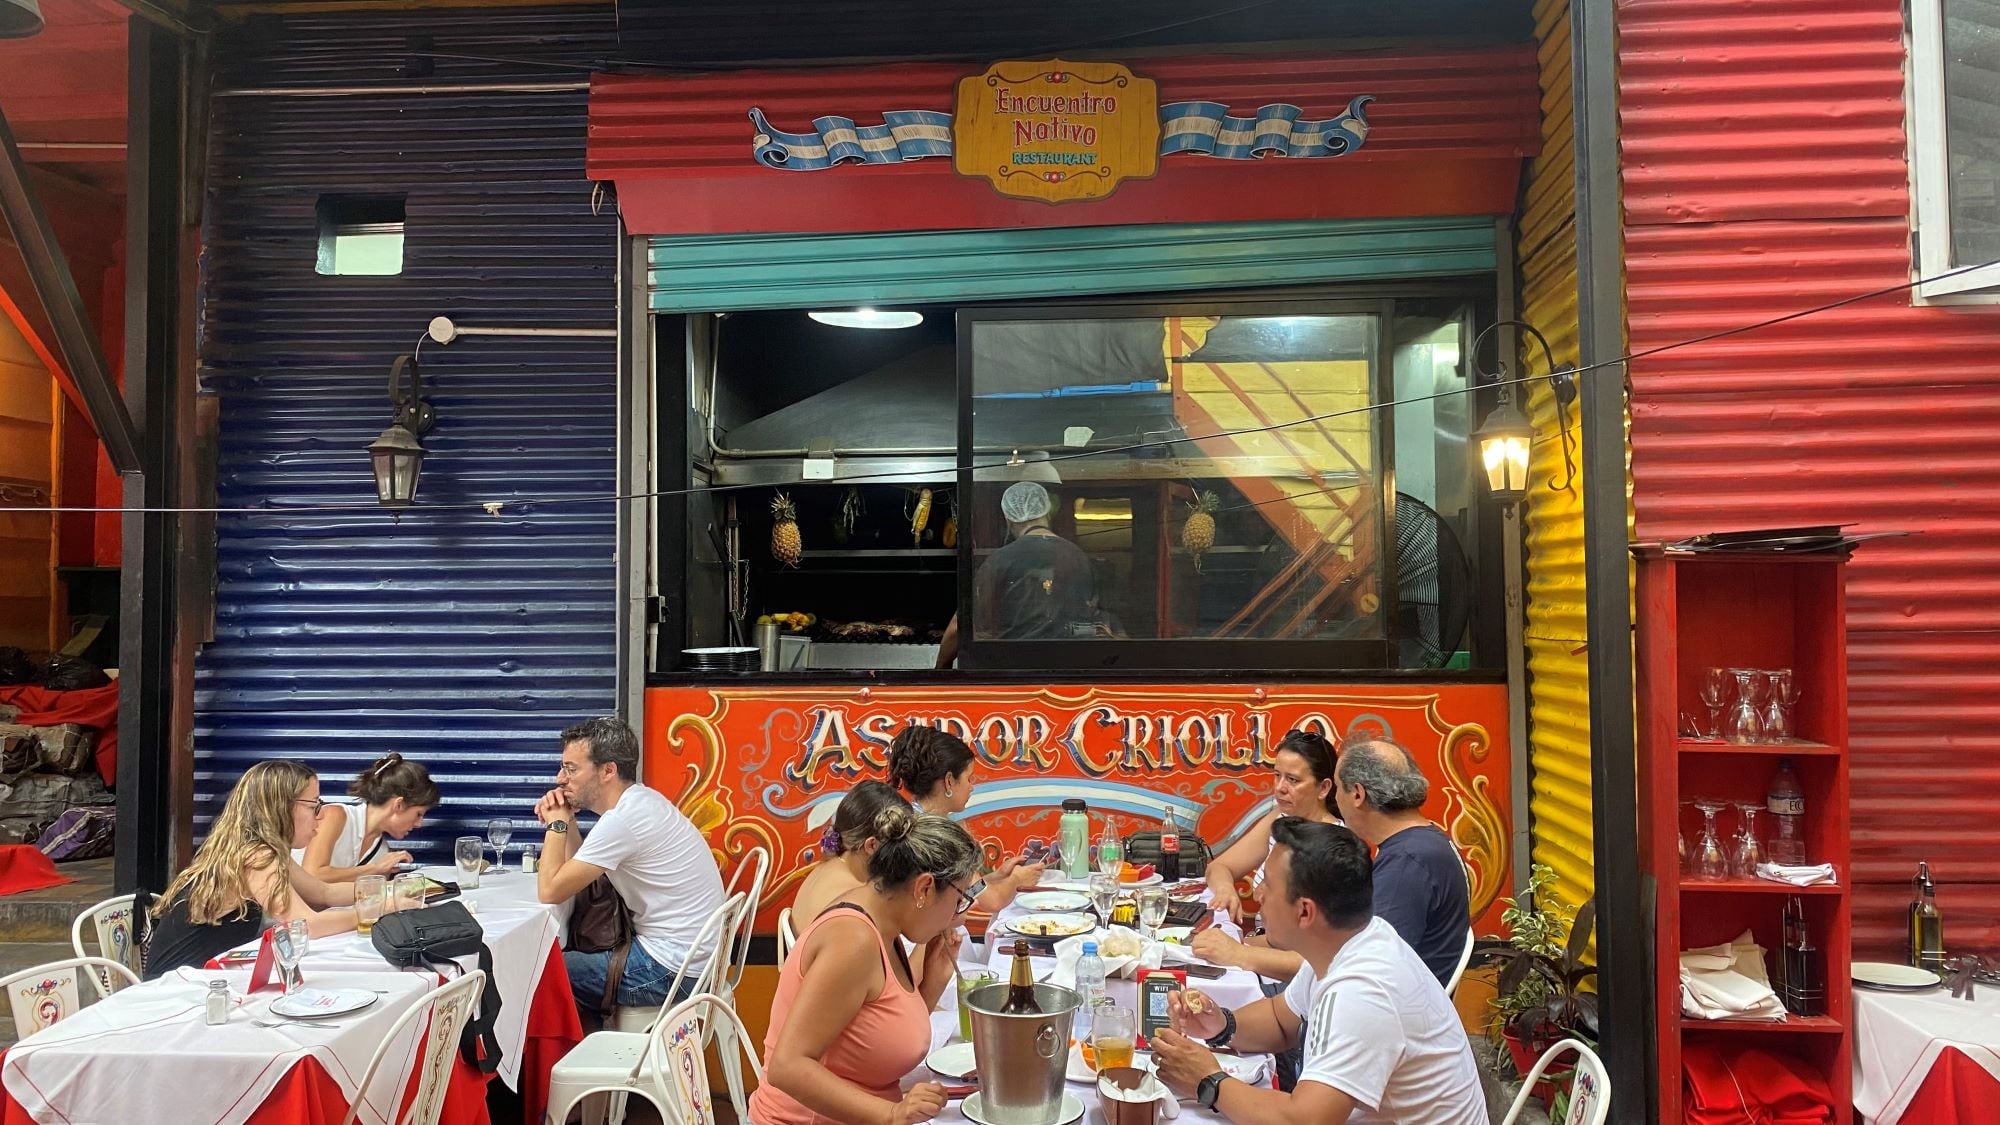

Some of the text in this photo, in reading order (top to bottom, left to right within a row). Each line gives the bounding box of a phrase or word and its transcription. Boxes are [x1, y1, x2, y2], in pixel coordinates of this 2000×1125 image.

[995, 87, 1118, 115] Encuentro
[1013, 116, 1098, 148] Nativo
[1012, 152, 1098, 166] RESTAURANT
[786, 708, 1057, 790] ASDOR
